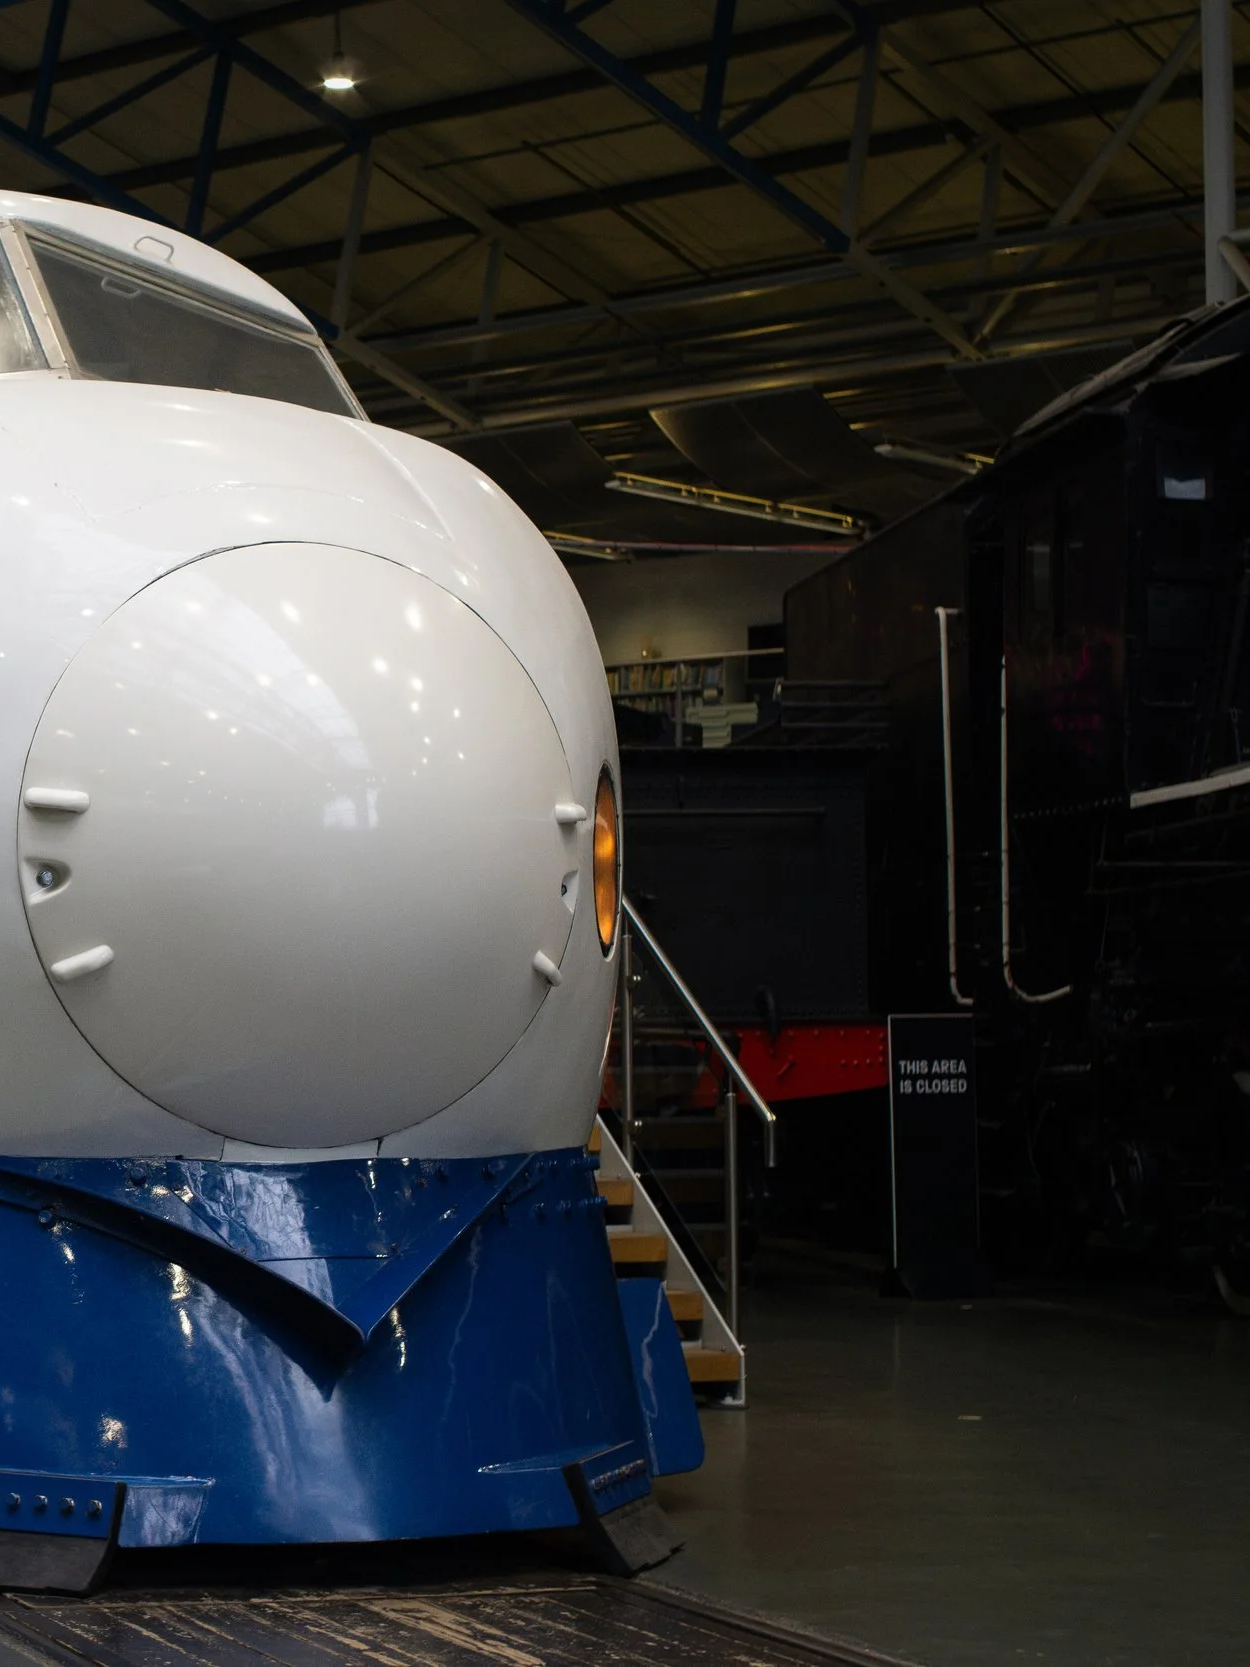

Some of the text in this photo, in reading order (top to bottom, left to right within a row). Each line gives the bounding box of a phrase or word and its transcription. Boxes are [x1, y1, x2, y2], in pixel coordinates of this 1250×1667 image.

[898, 1059, 967, 1074] THIS AREA
[900, 1078, 968, 1094] IS CLOSED
